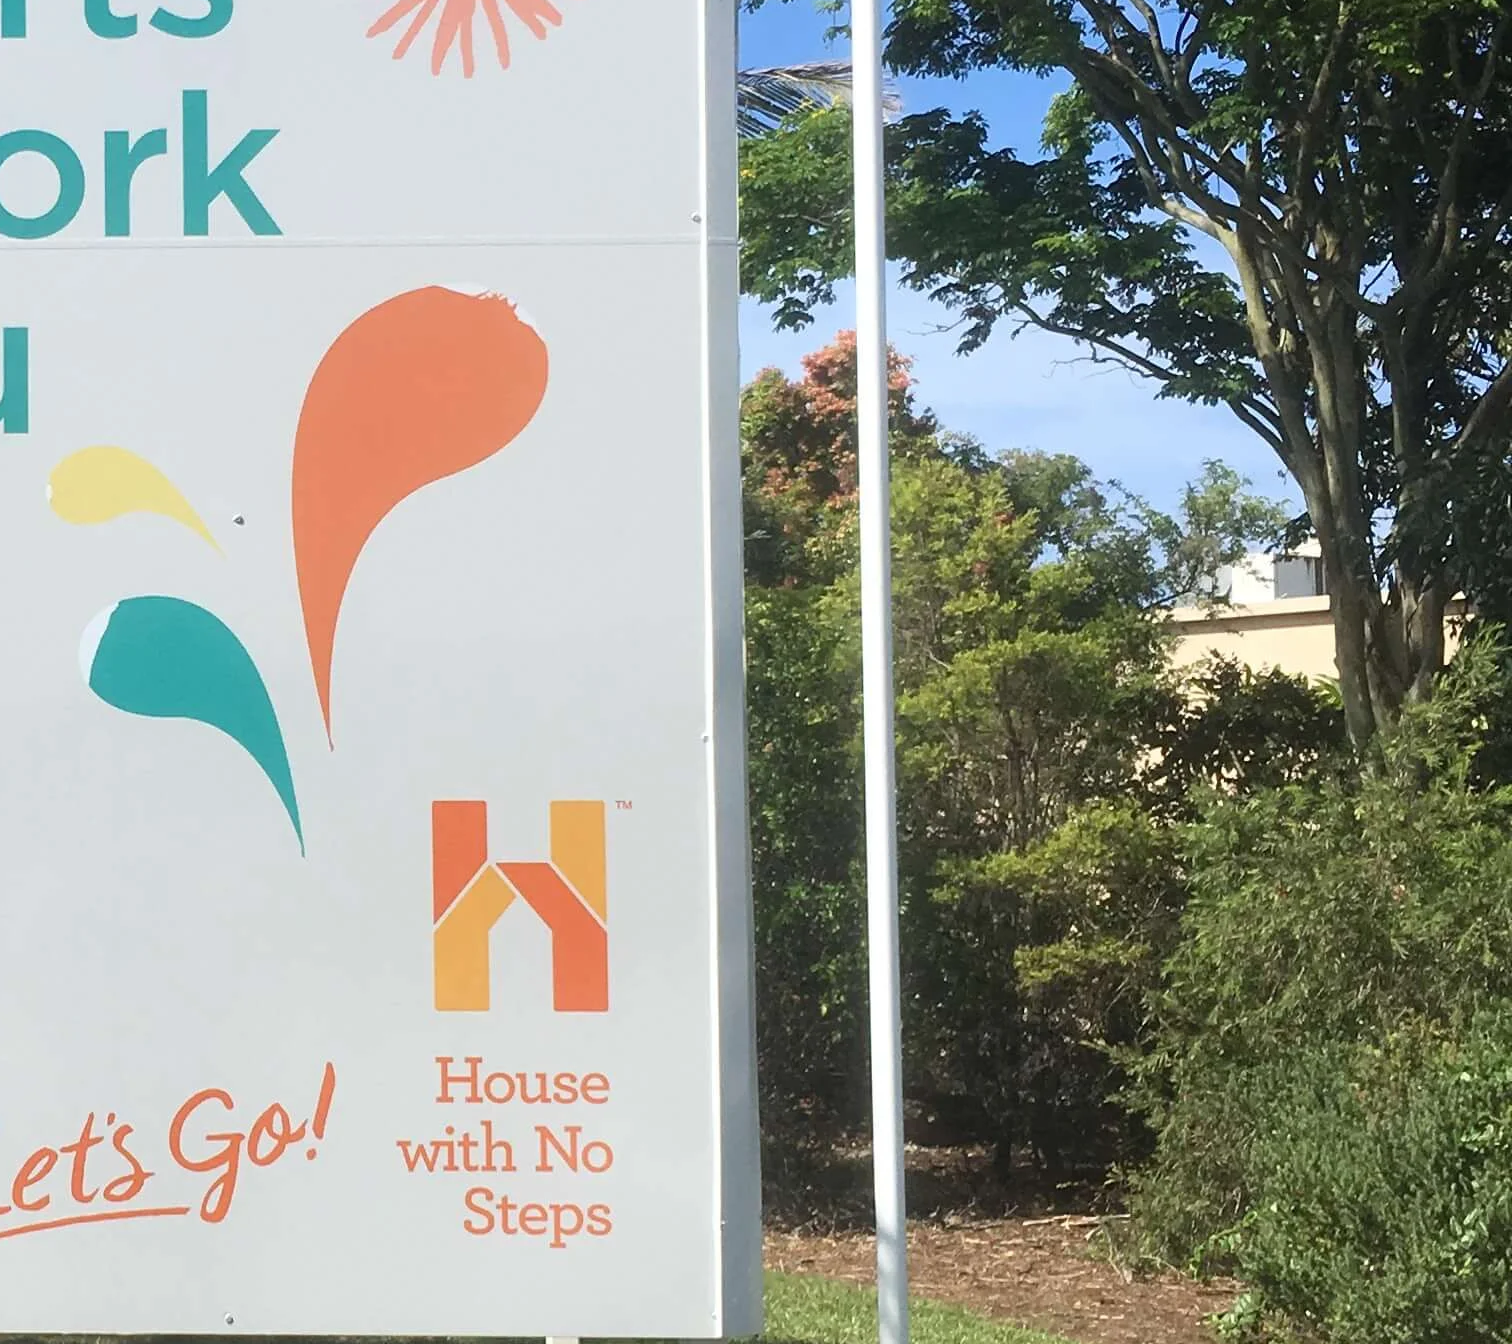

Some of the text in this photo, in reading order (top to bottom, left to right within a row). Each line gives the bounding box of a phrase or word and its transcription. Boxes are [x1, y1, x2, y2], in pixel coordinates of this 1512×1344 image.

[431, 799, 610, 1013] H
[434, 1056, 610, 1105] House
[168, 1061, 336, 1224] Go!
[395, 1119, 614, 1174] with No
[463, 1186, 613, 1249] Steps
